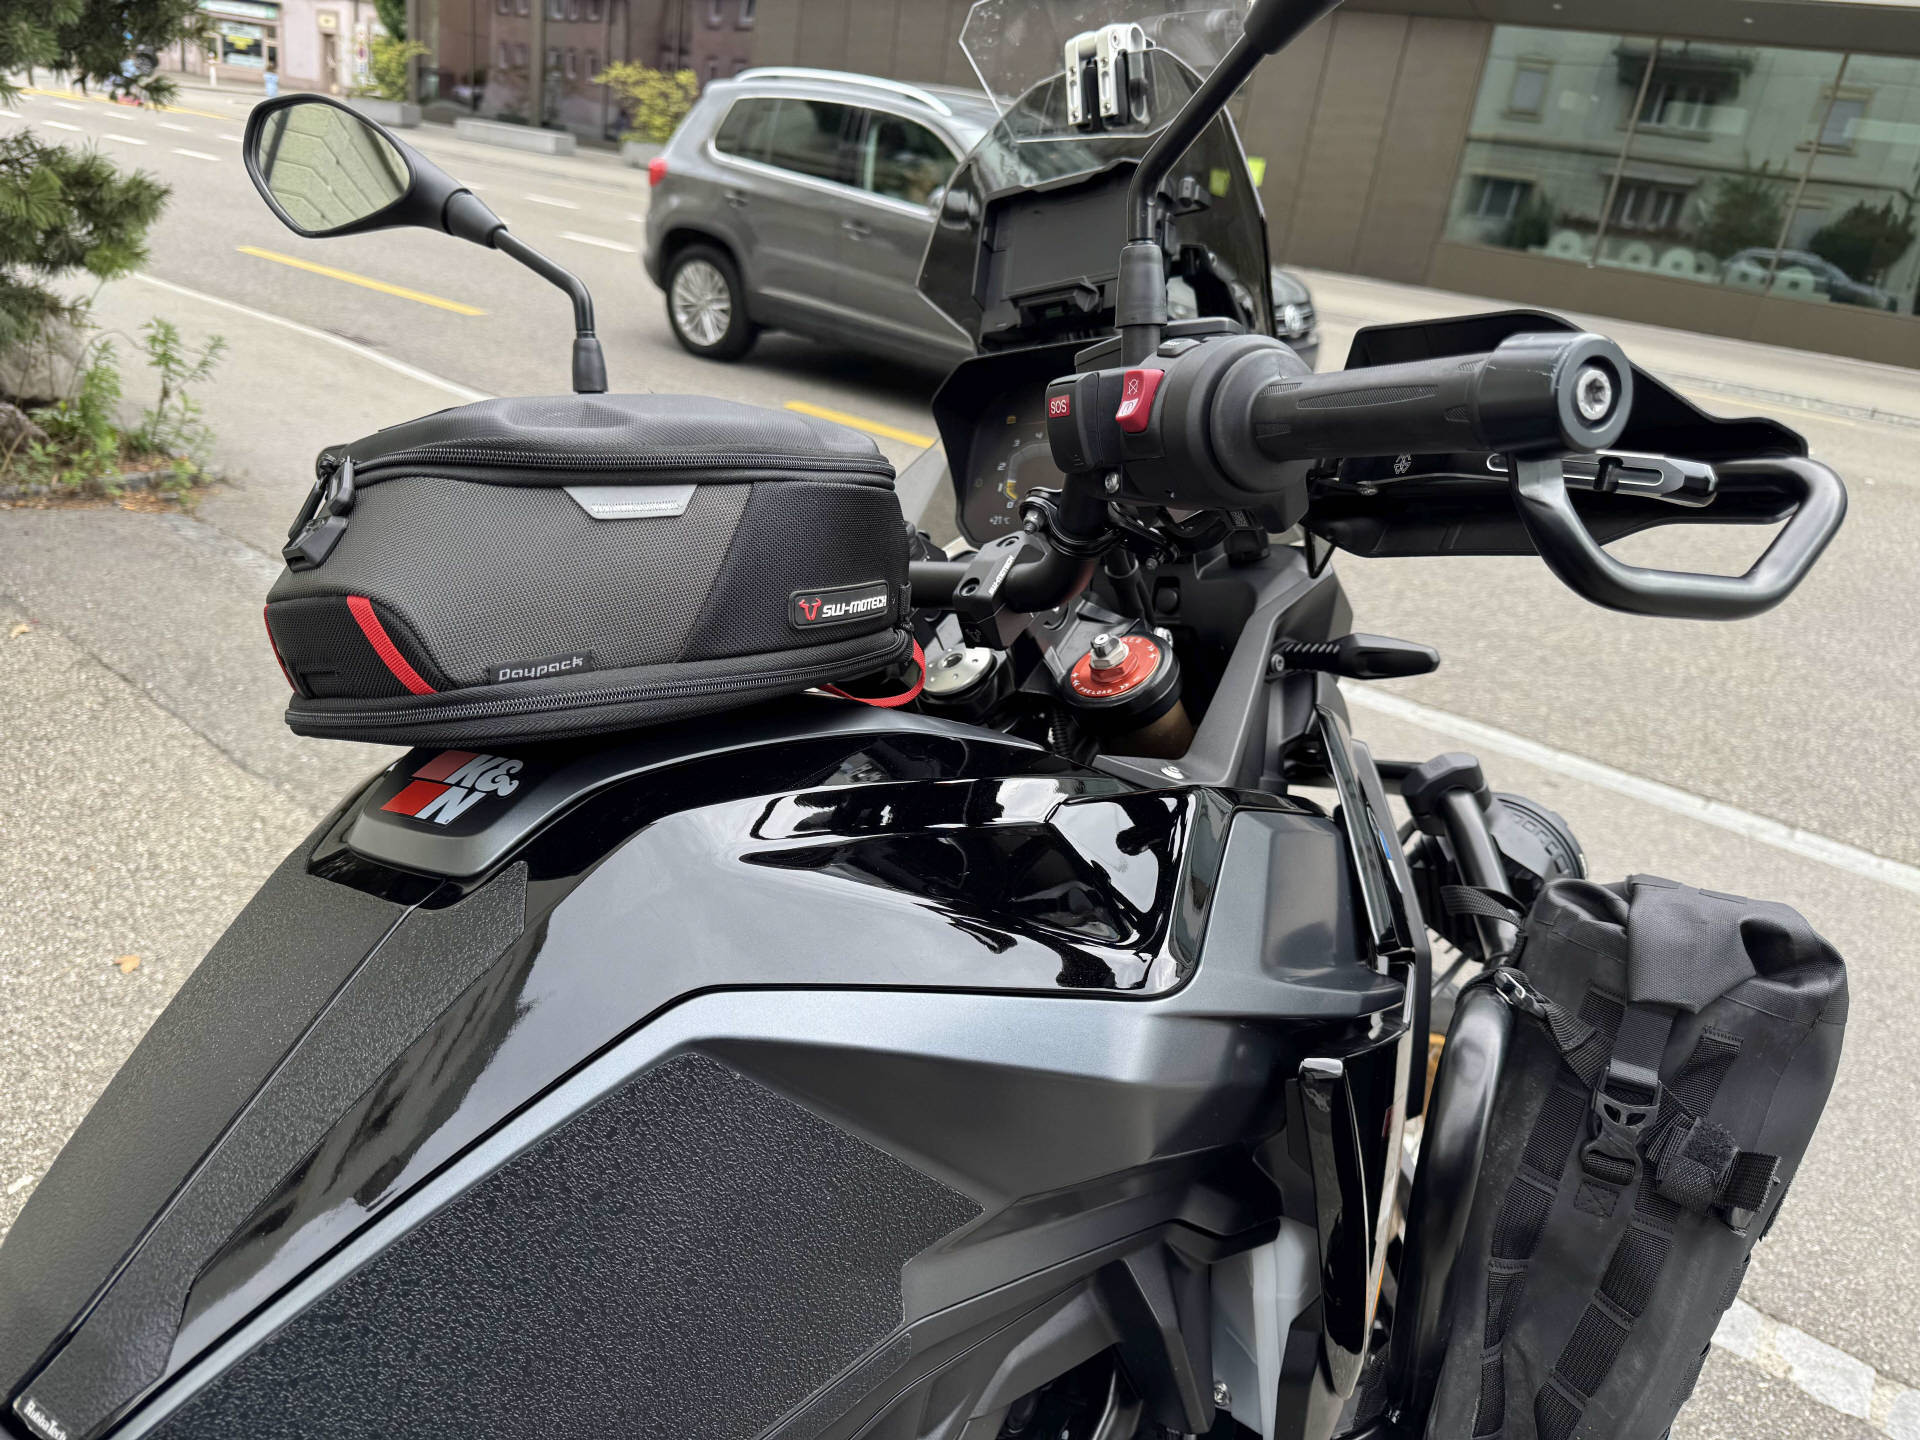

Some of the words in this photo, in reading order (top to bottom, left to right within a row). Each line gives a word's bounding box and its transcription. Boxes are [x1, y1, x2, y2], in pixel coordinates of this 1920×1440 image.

[1050, 399, 1067, 414] SOS
[997, 462, 1006, 471] 2
[821, 595, 887, 618] SW-MOTECH
[498, 656, 584, 681] Daypack
